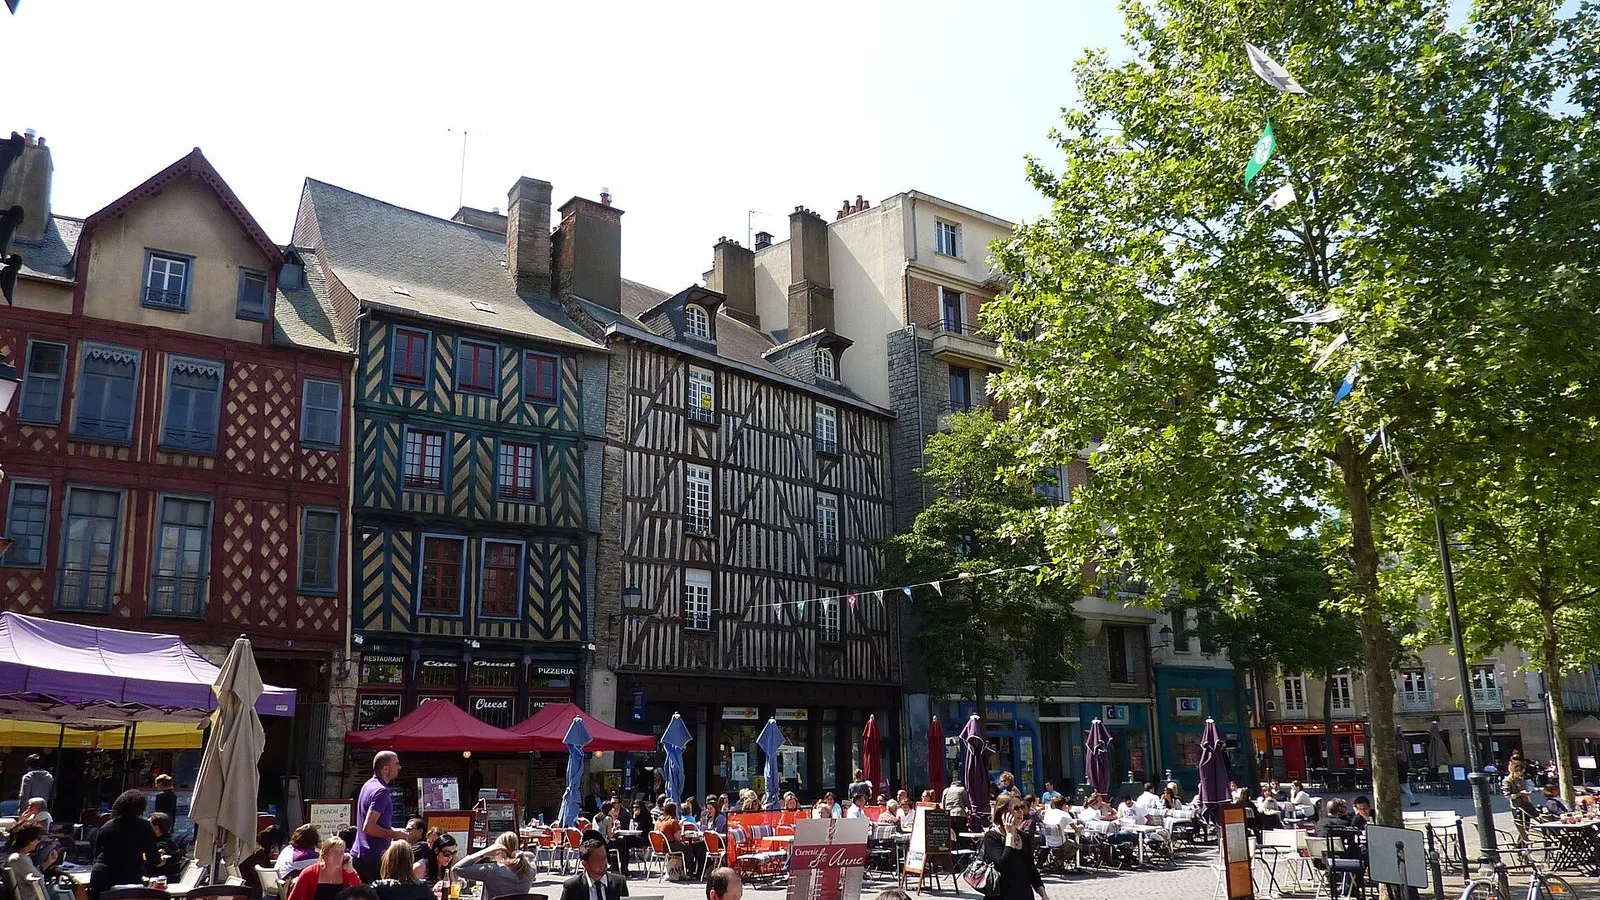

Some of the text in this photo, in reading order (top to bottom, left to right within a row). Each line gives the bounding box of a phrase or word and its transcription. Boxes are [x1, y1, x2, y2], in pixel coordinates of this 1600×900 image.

[363, 655, 405, 663] RESTAURANT
[473, 660, 516, 668] Ouest
[538, 667, 574, 675] PIZZERIA
[475, 698, 508, 710] Ouest
[828, 847, 865, 867] Anne
